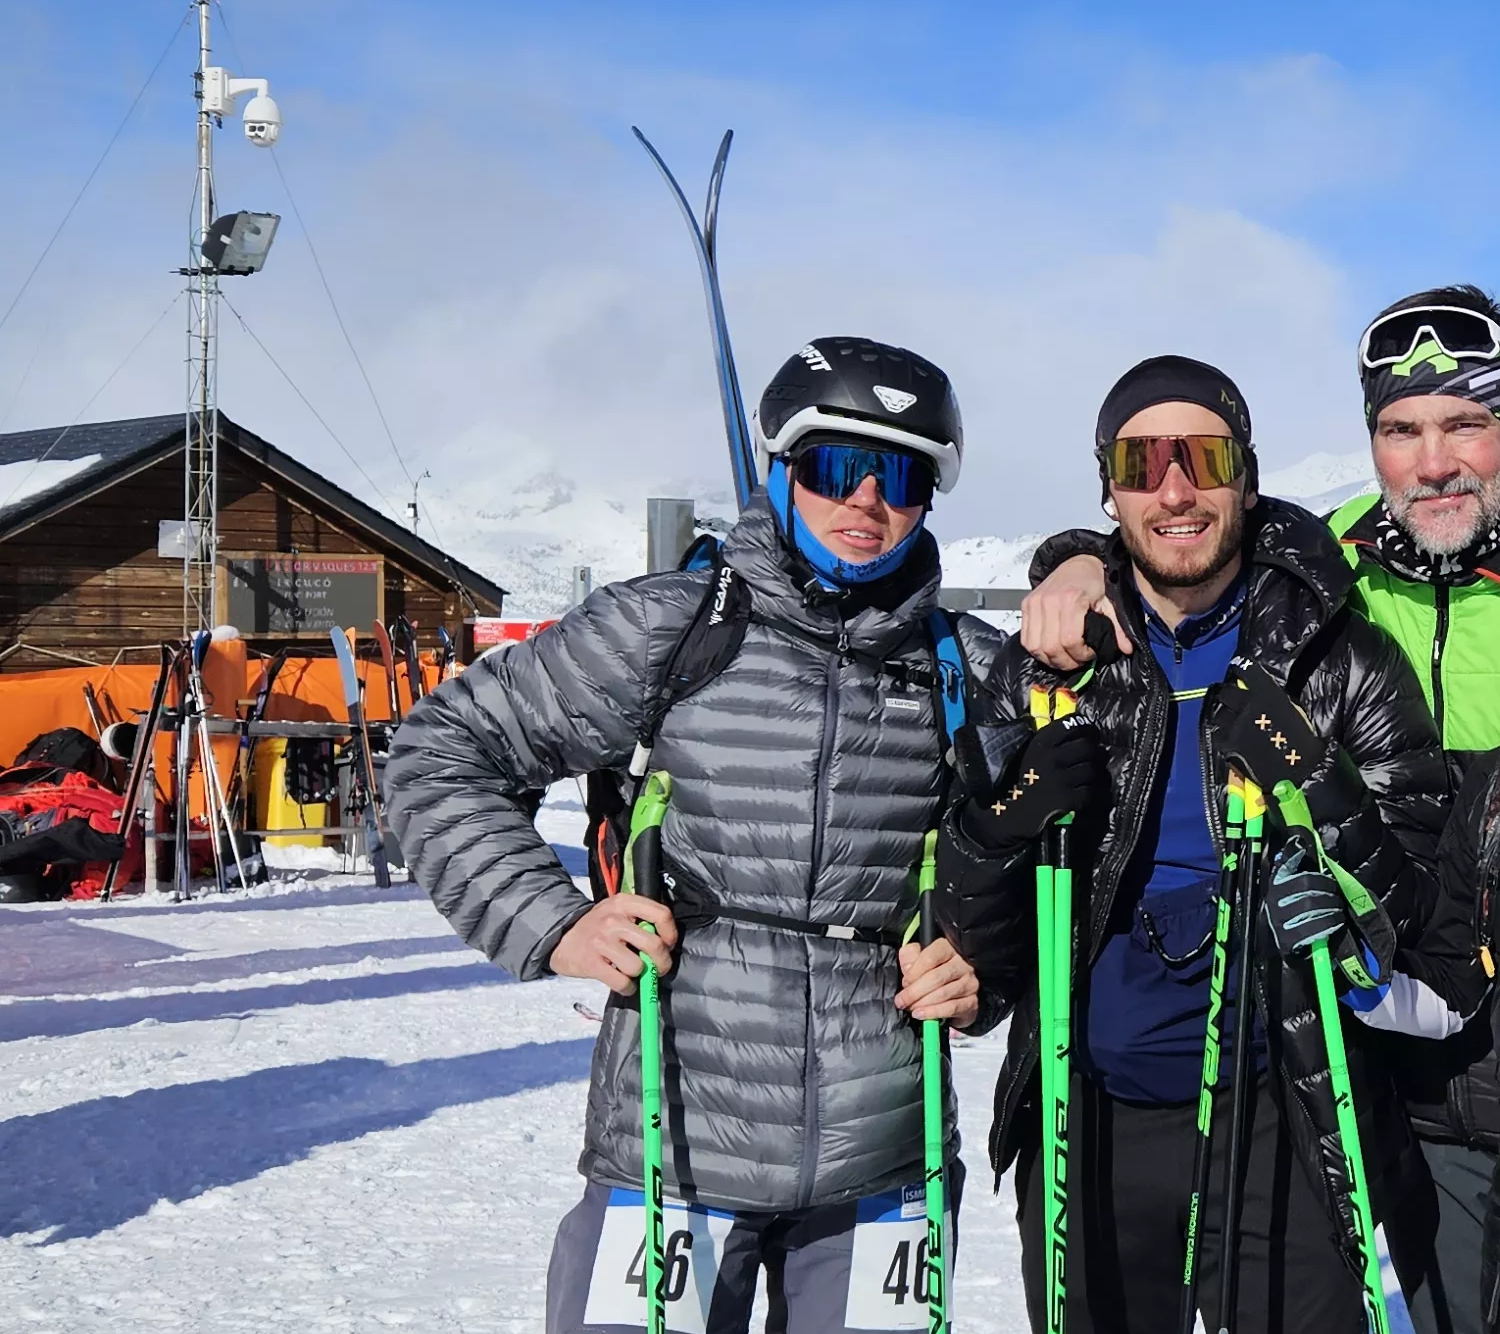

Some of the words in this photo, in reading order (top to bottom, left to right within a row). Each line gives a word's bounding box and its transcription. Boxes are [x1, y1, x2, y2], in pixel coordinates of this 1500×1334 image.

[714, 566, 734, 612] CAMP
[1198, 896, 1231, 1137] BONES
[624, 1229, 694, 1302] 46
[1183, 1238, 1195, 1285] CARBON
